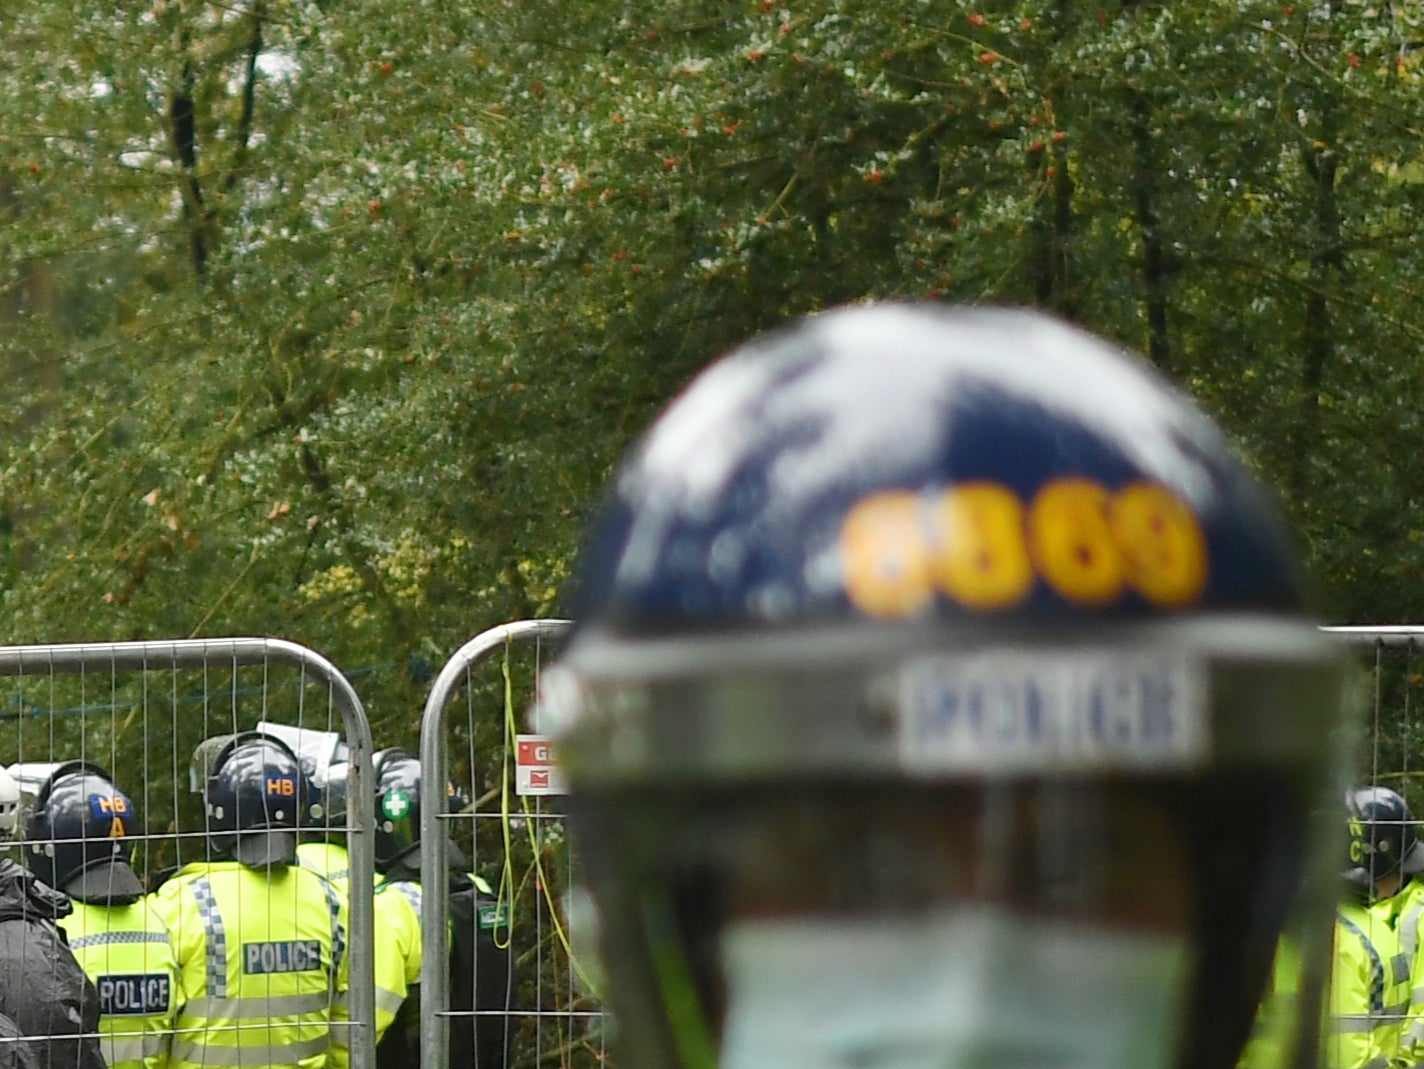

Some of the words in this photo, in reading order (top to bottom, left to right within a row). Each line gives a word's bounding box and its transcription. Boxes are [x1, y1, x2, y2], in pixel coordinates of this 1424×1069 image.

[267, 778, 294, 797] HB
[98, 796, 127, 813] HB
[109, 817, 125, 838] A
[246, 941, 319, 974] POLICE
[99, 978, 169, 1009] POLICE
